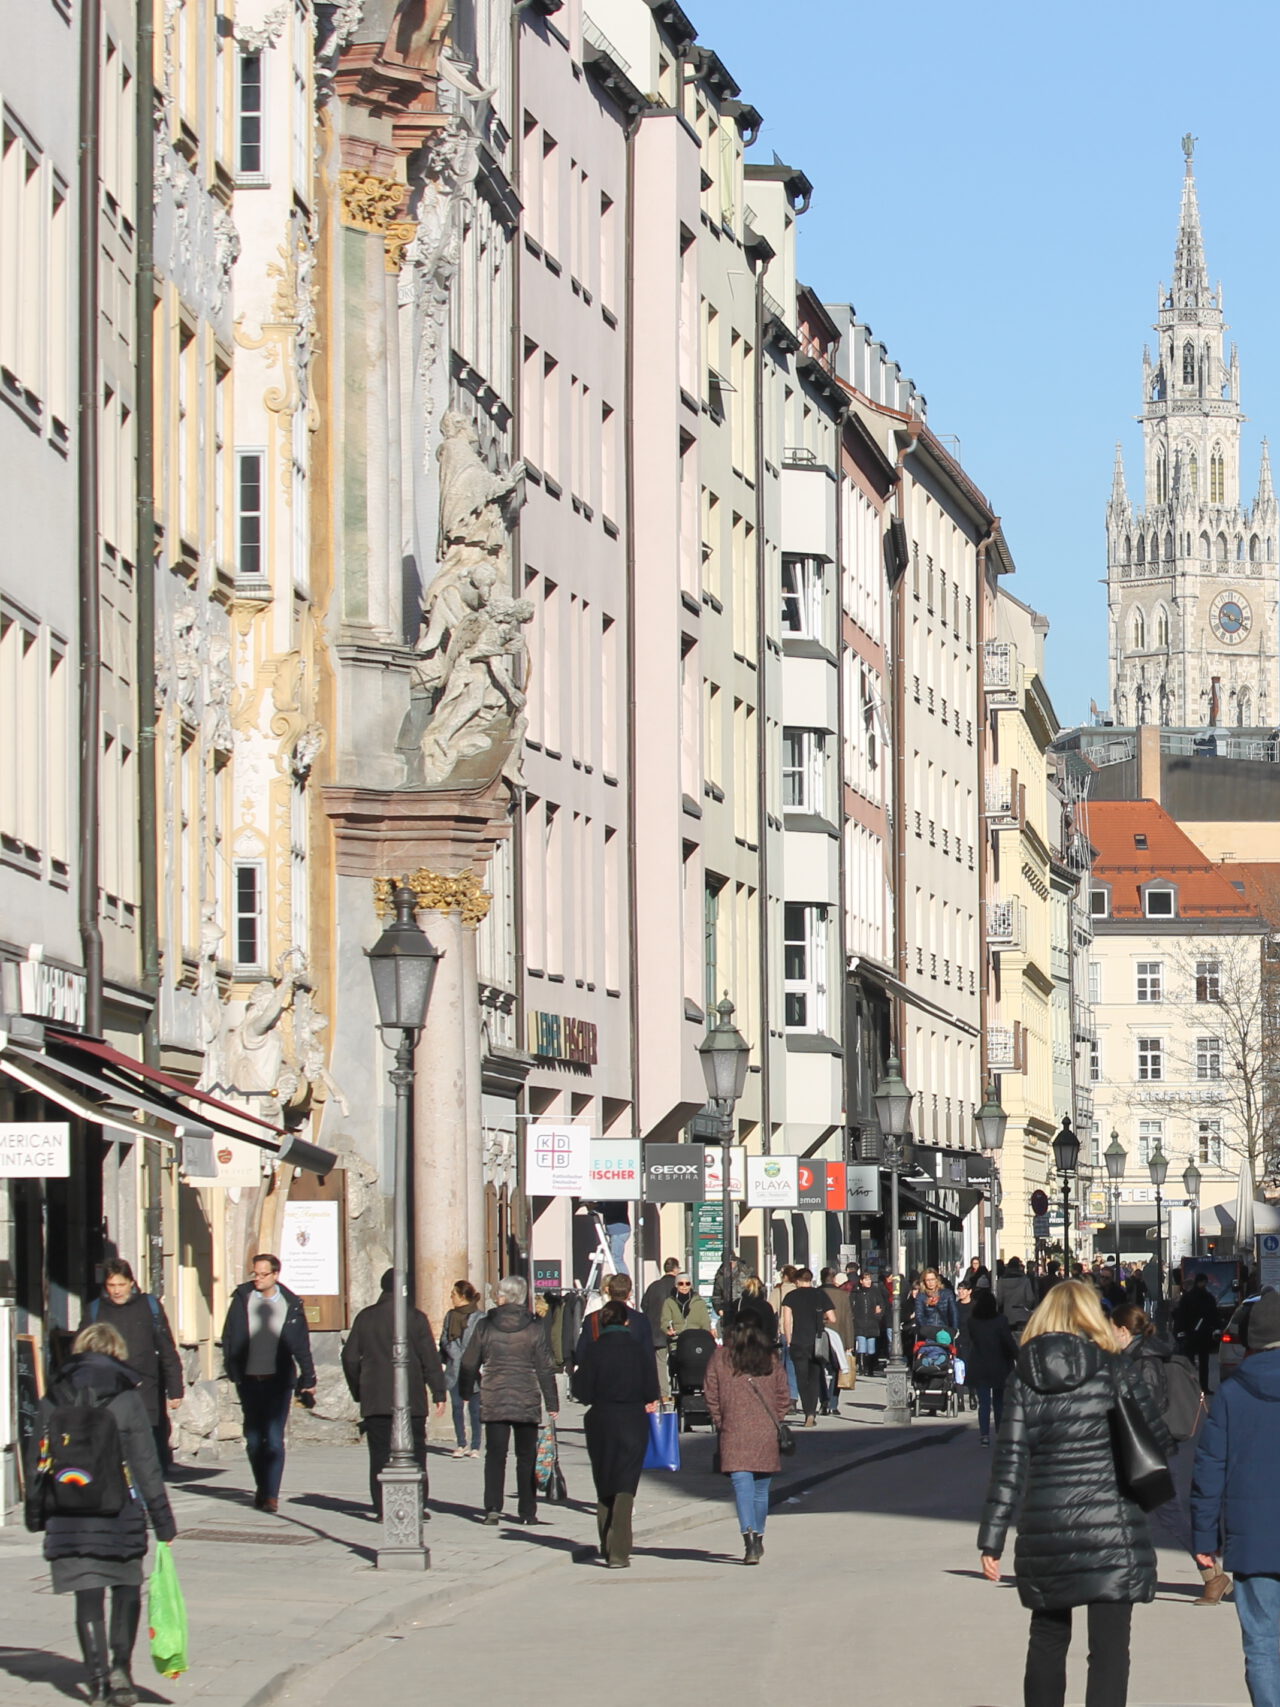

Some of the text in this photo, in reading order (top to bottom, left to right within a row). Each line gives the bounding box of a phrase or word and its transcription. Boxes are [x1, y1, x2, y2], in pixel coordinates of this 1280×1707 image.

[1137, 1089, 1226, 1103] TRETTER
[0, 1134, 62, 1148] MERICAN
[0, 1152, 55, 1167] INTAGE
[593, 1159, 635, 1169] EDER
[589, 1170, 635, 1180] ISCHER
[650, 1164, 698, 1175] GEOX
[754, 1180, 792, 1191] PLAYA
[799, 1196, 822, 1204] emon
[536, 1270, 560, 1279] DER
